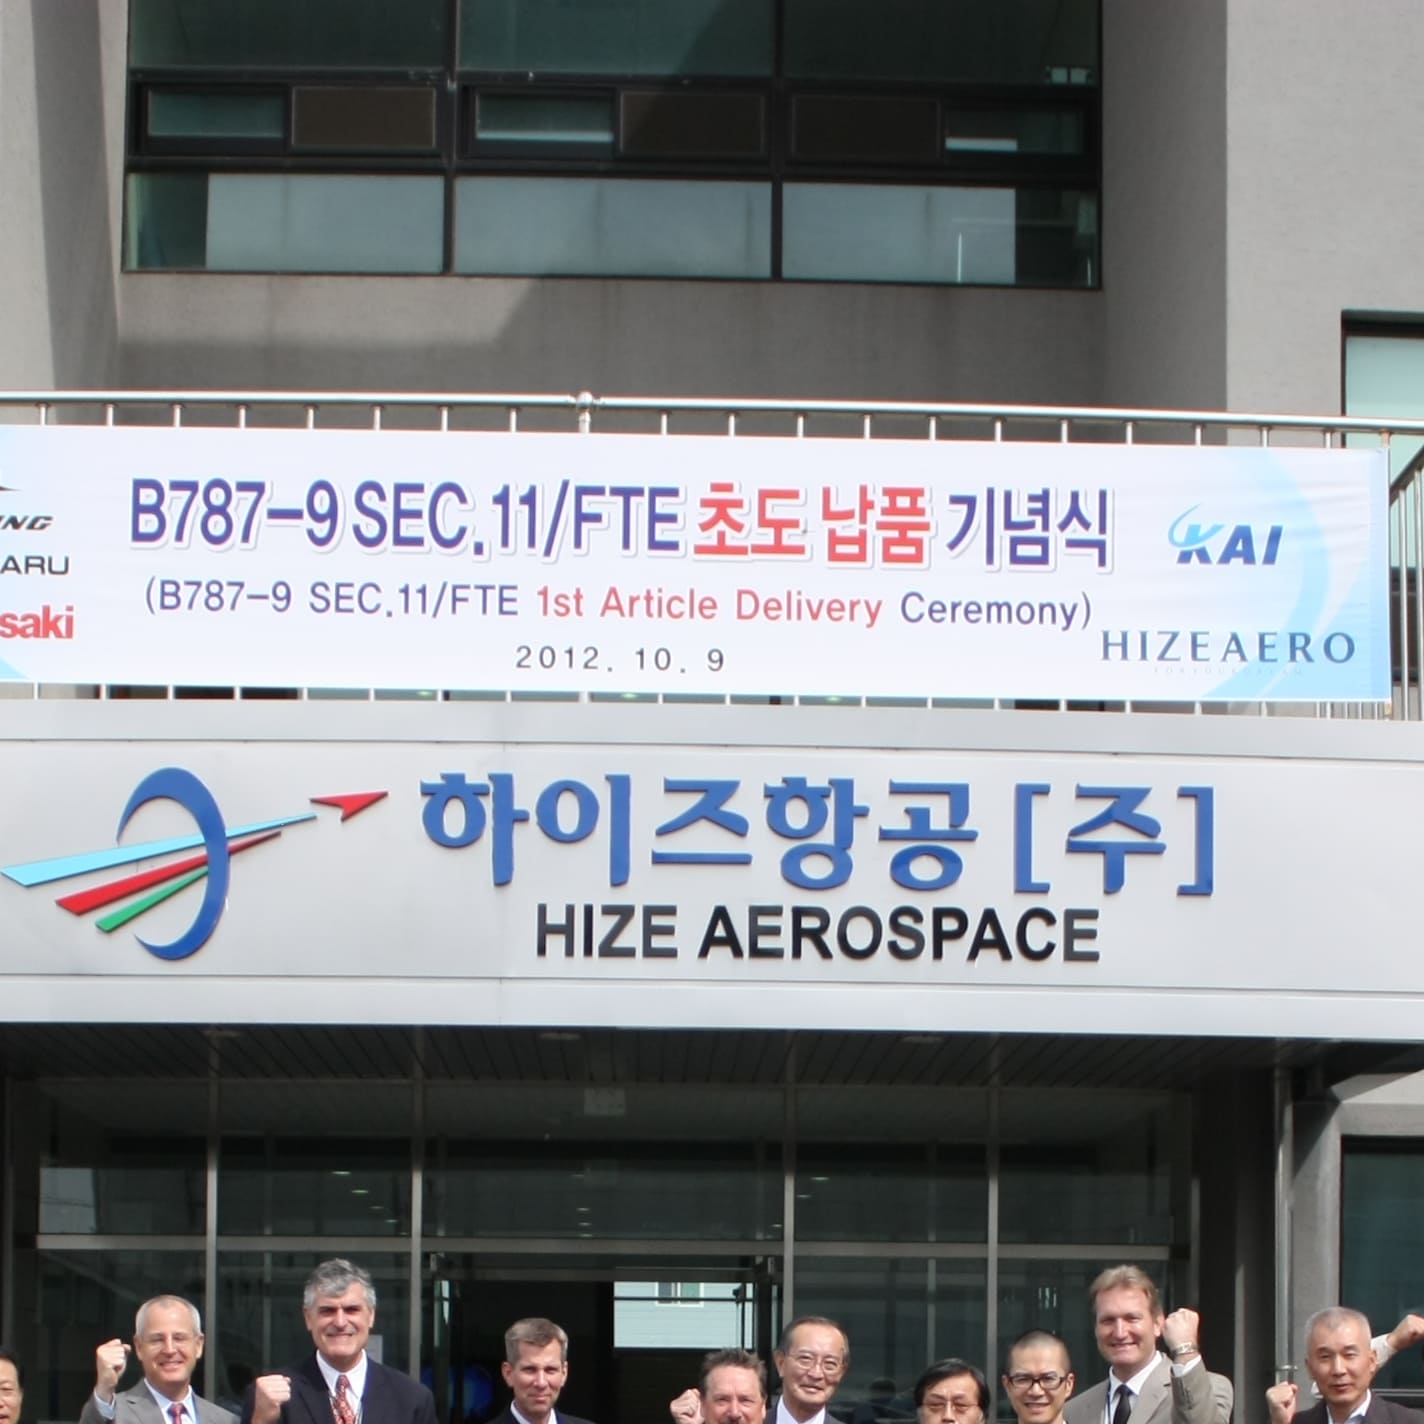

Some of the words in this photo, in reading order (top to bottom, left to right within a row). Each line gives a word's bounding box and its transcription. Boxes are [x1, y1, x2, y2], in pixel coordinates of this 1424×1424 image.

[131, 478, 339, 547] B787-9
[693, 482, 806, 556] 초도
[821, 484, 931, 564] 납품
[946, 486, 1108, 568] 기념식
[1168, 513, 1284, 566] KAI
[145, 576, 292, 615] (B787-9
[308, 580, 519, 618] SEC.11/FTE
[536, 585, 584, 617] 1st
[599, 586, 718, 620] Article
[735, 588, 883, 629] Delivery
[900, 590, 1091, 632] Ceremony)
[515, 645, 614, 673] 2012.
[635, 647, 686, 674] 10.
[707, 648, 725, 672] 9
[536, 903, 678, 959] HIZE
[697, 904, 1101, 963] AEROSPACE
